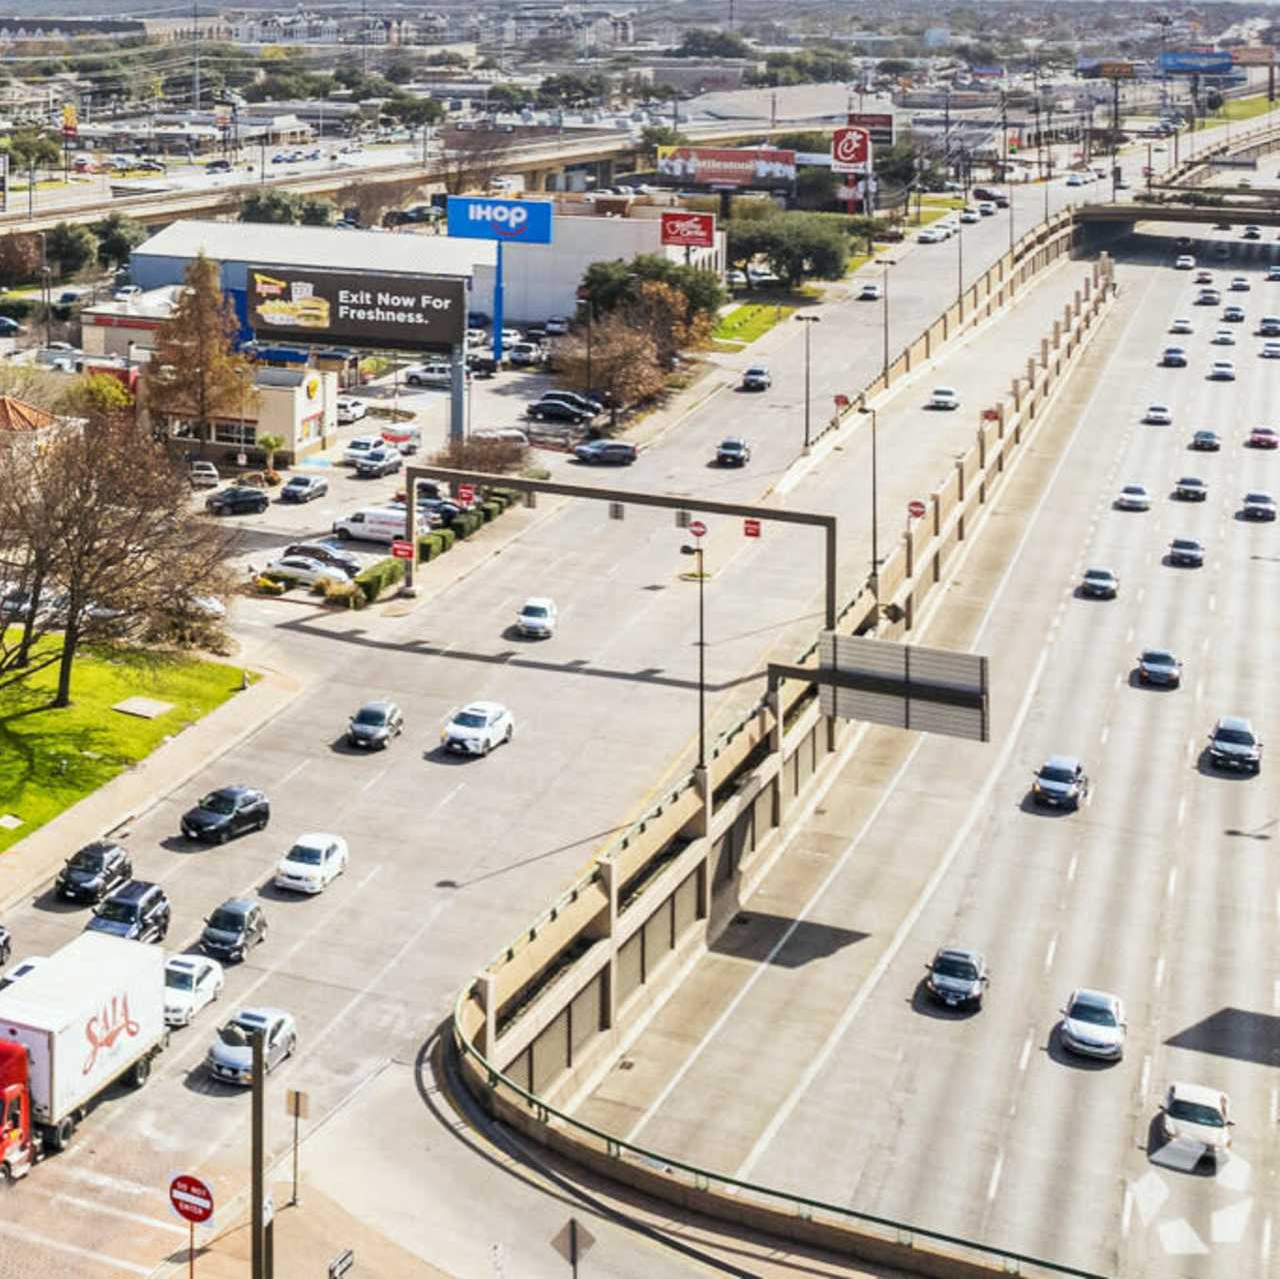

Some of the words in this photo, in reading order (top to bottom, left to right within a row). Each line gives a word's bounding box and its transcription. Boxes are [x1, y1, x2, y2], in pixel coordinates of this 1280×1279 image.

[468, 203, 528, 228] IHOP
[338, 290, 372, 305] Exit
[377, 293, 416, 308] Now
[421, 295, 452, 310] For
[338, 305, 430, 325] Freshness.
